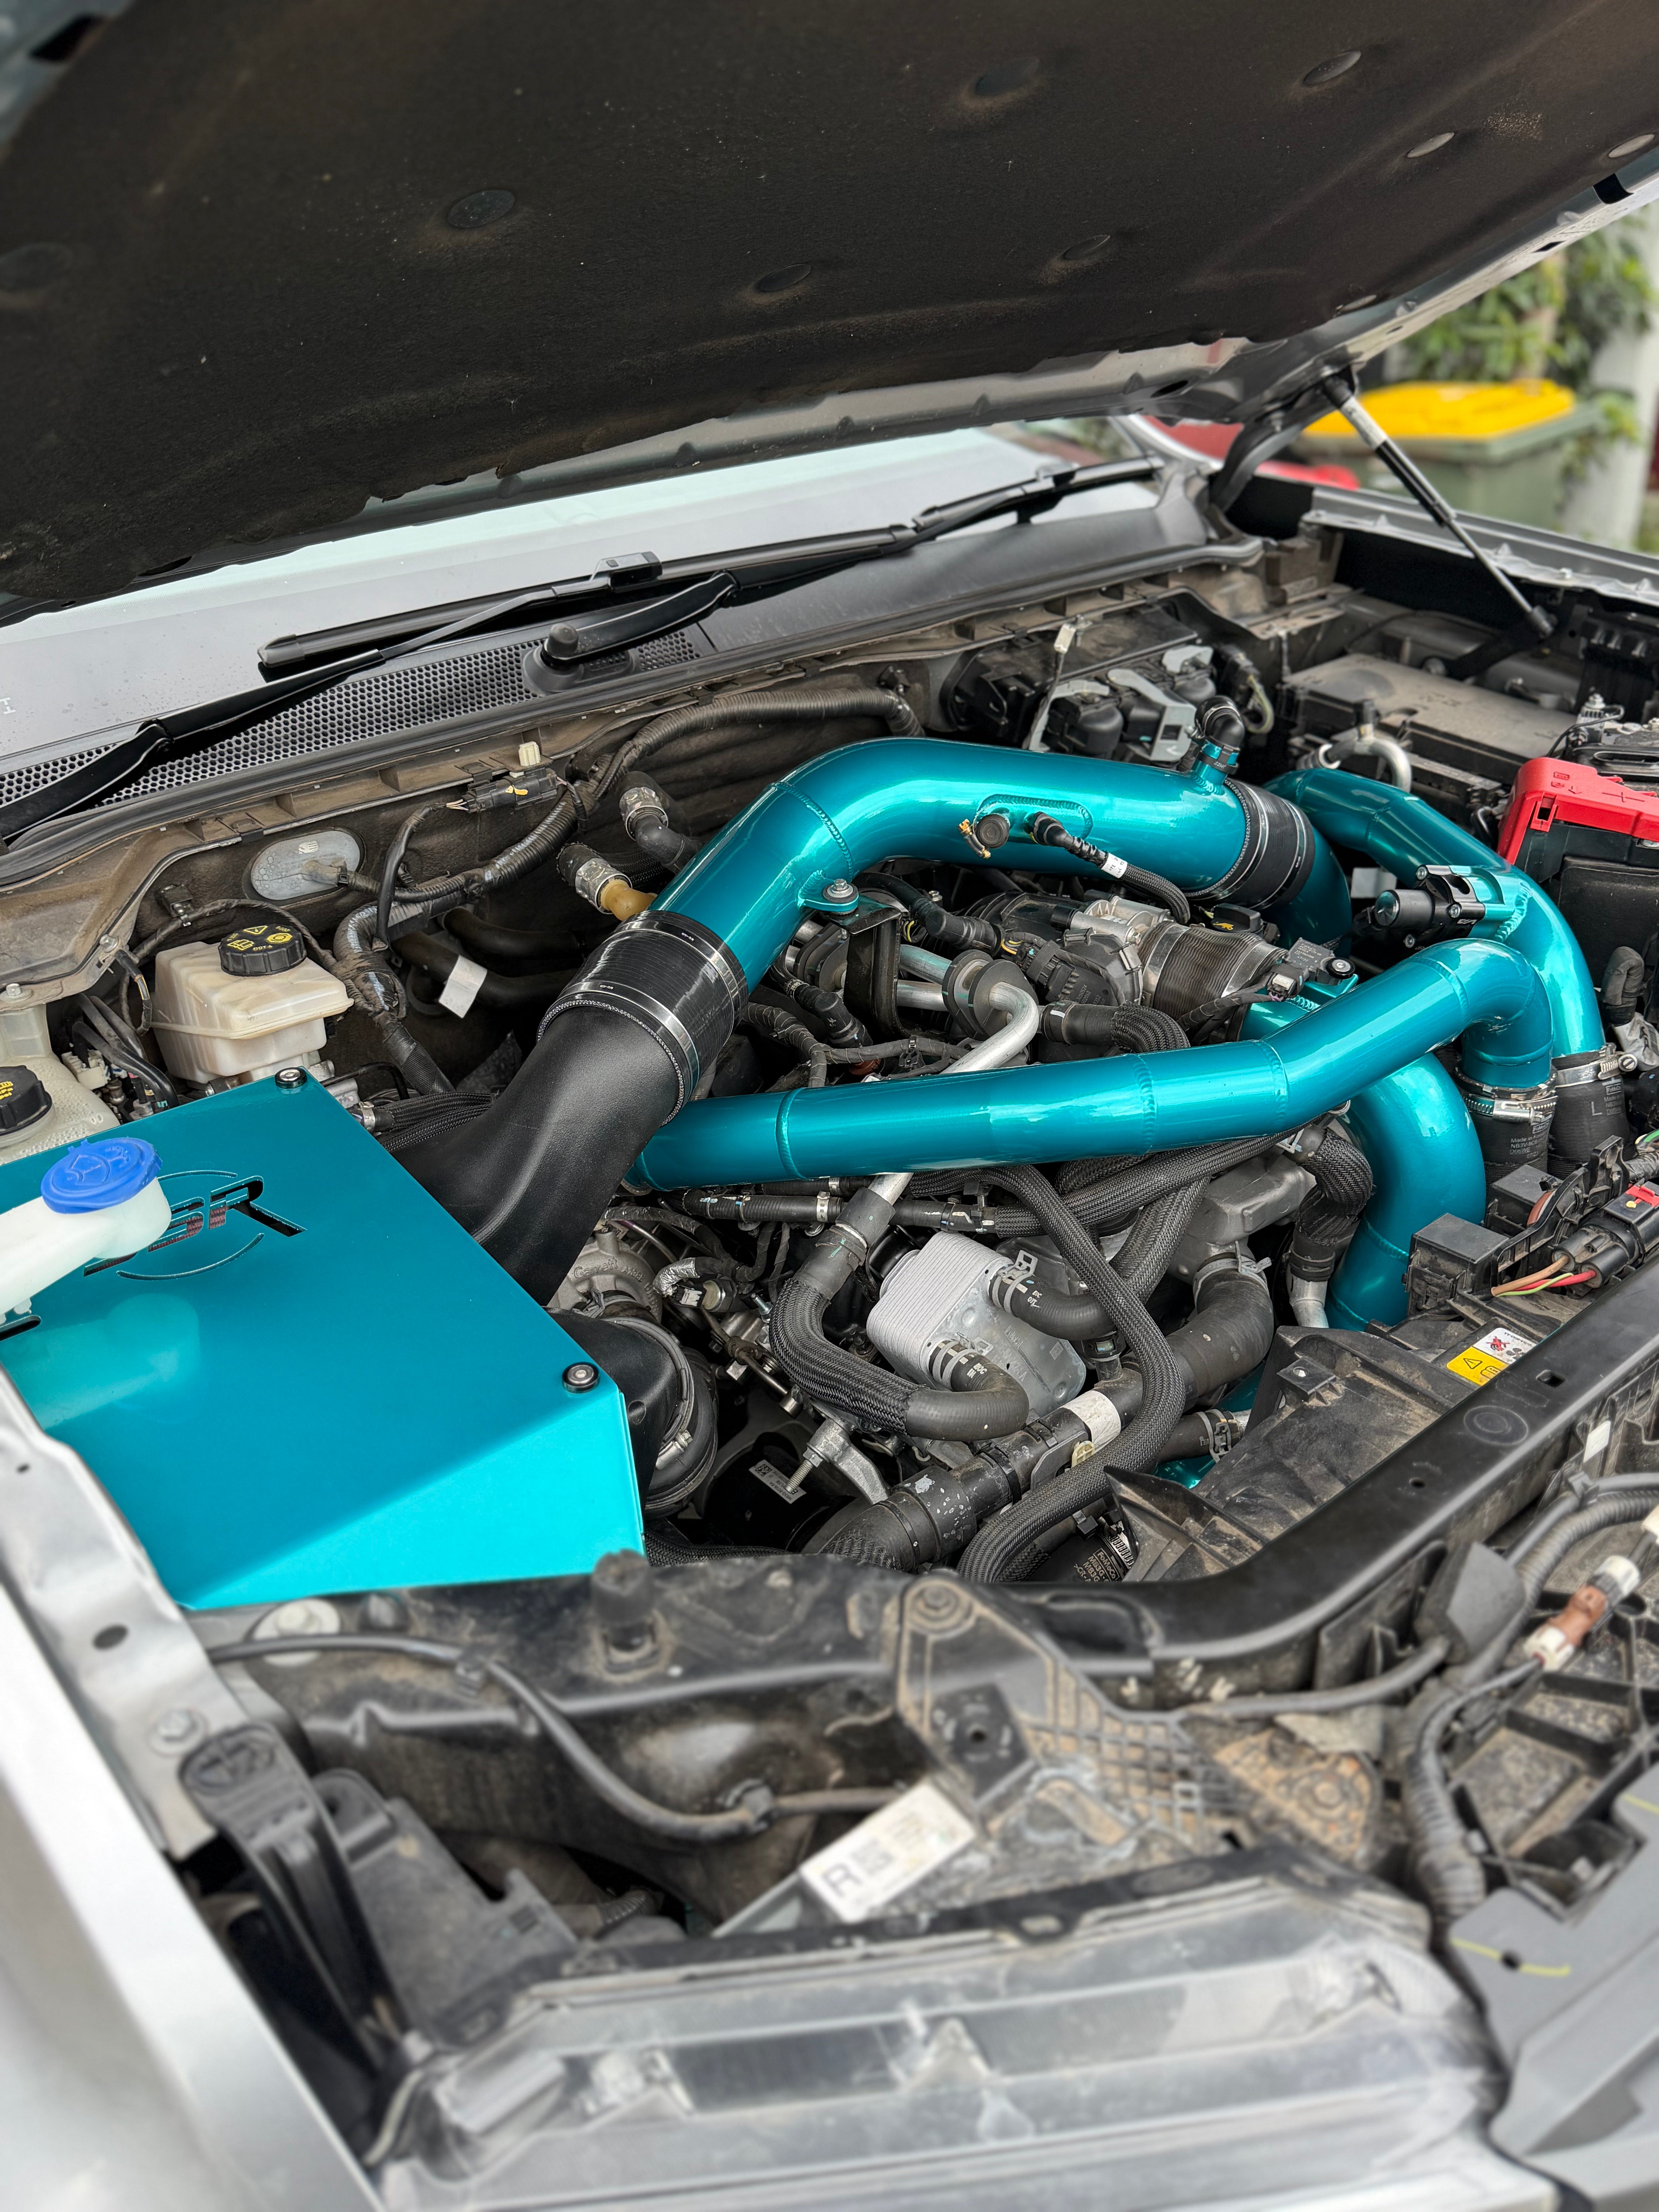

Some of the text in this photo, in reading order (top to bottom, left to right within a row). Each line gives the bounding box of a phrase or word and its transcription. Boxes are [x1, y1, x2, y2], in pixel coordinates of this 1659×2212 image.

[1591, 1101, 1602, 1116] L
[574, 1257, 618, 1278] Garrett
[967, 1368, 977, 1379] IN
[973, 1363, 988, 1374] EOC
[1097, 1551, 1116, 1579] FoMoCo
